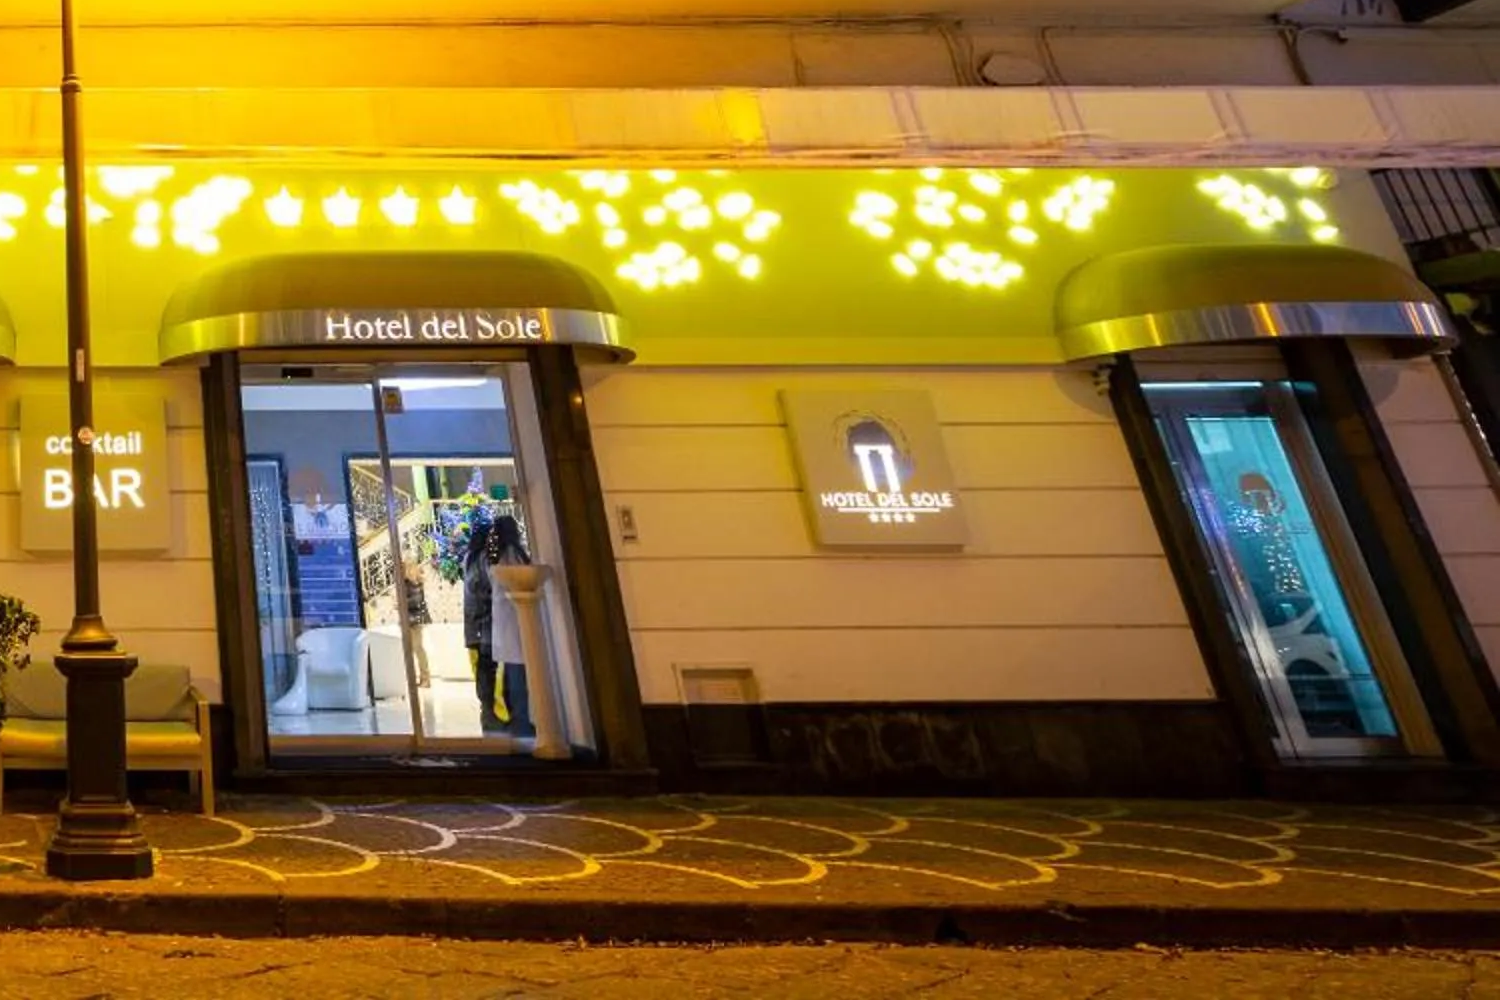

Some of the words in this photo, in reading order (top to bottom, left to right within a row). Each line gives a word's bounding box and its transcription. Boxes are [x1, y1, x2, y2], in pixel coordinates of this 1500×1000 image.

[326, 313, 413, 340] Hotel
[421, 313, 469, 340] del
[476, 313, 542, 340] Sole
[45, 431, 141, 455] coktail
[820, 492, 874, 507] HOTEL
[876, 493, 909, 507] DEL
[911, 492, 954, 507] SOLE
